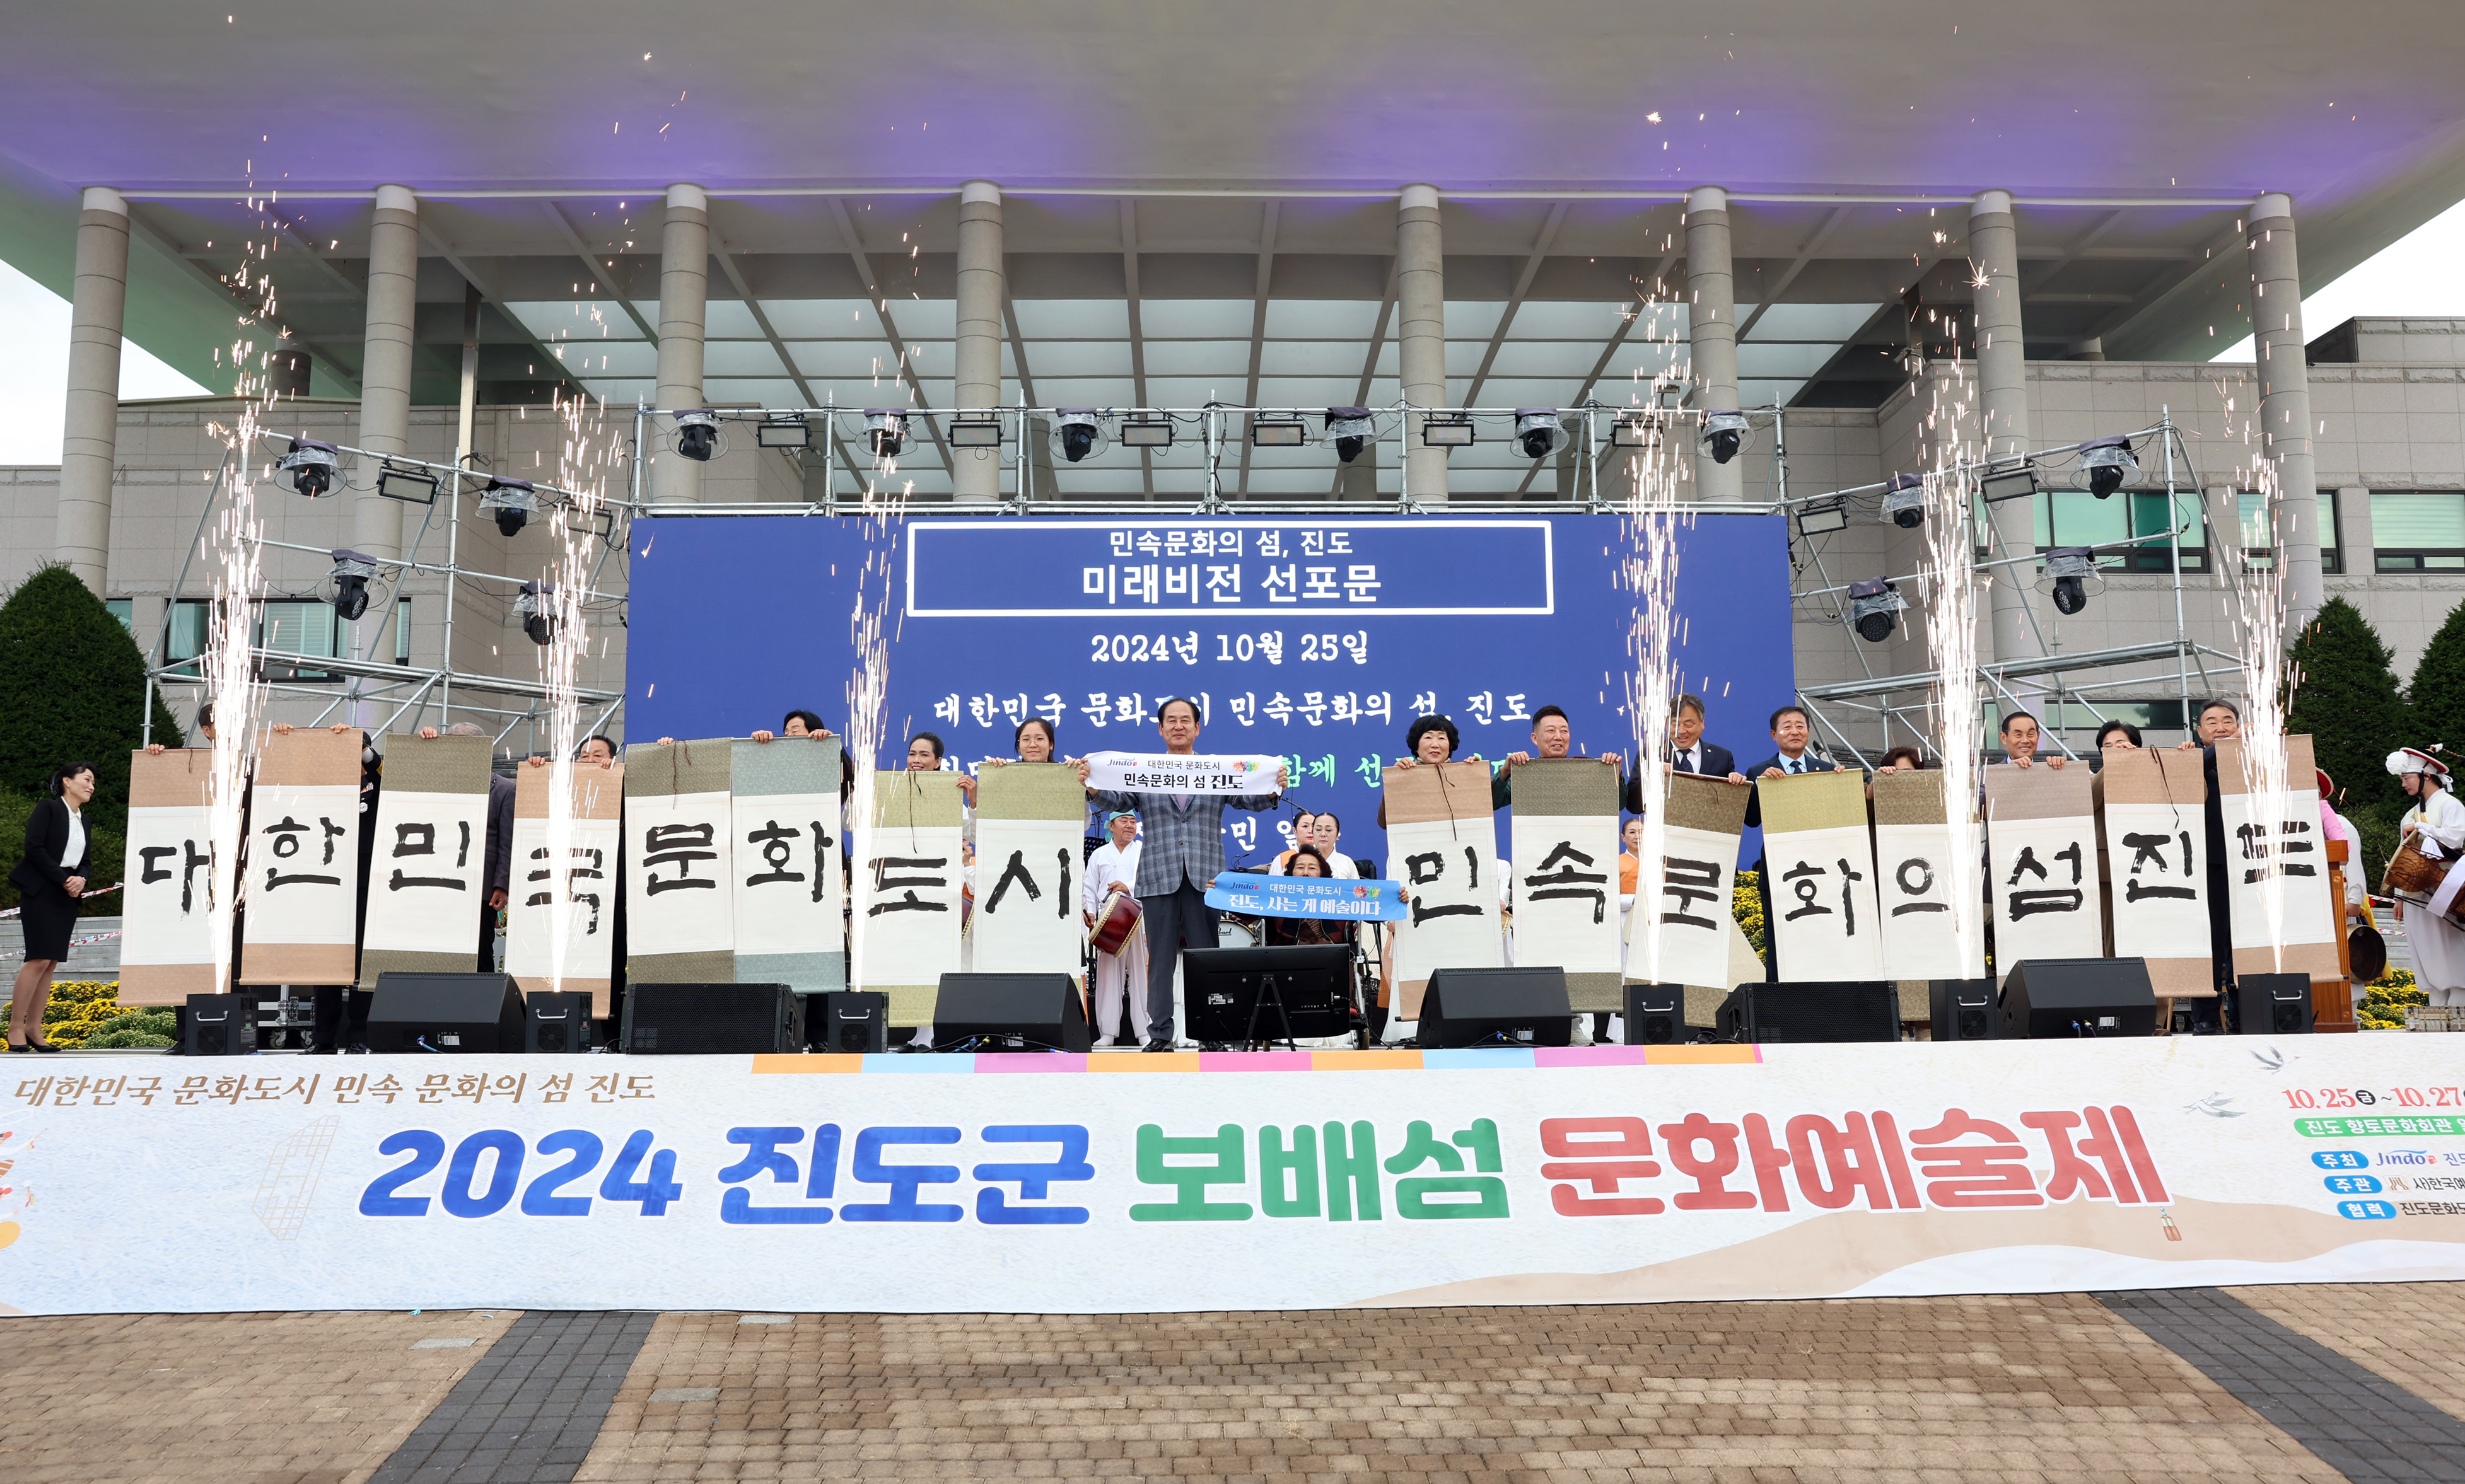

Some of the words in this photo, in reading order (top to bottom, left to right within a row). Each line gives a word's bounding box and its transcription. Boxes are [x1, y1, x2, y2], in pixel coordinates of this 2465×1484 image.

[1110, 530, 1243, 557] 민속문화의
[1256, 530, 1289, 559] 섬,
[1300, 531, 1353, 557] 진도
[1083, 564, 1242, 604] 미래비전
[1261, 564, 1382, 602] 선포문
[1092, 631, 1199, 665] 2024년
[1216, 630, 1283, 665] 10월
[1300, 630, 1368, 664] 25일
[934, 692, 1066, 728] 대한민국
[1229, 691, 1391, 726] 민속문화의
[1466, 690, 1531, 726] 진도
[1148, 759, 1182, 769] 대한민국
[1186, 760, 1220, 770] 문화도시
[1124, 773, 1188, 788] 민속문화의
[1193, 775, 1206, 789] 섬
[1211, 774, 1244, 789] 진도
[1269, 883, 1304, 894] 대한민국
[1307, 884, 1341, 896] 문화도시
[1228, 894, 1263, 911] 진도,
[1267, 896, 1298, 912] 사는
[1302, 898, 1317, 914] 게
[1320, 900, 1382, 916] 예술이다
[14, 1075, 162, 1107] 대한민국
[173, 1074, 320, 1106] 문화도시
[333, 1073, 404, 1104] 민속
[416, 1072, 527, 1104] 문화의
[538, 1072, 573, 1104] 섬
[585, 1072, 656, 1103] 진도
[2304, 1120, 2343, 1135] 진도
[2344, 1118, 2452, 1134] 향토문화회관
[358, 1128, 683, 1218] 2024
[717, 1123, 1096, 1225] 진도군
[1128, 1117, 1511, 1222] 보배섬
[1539, 1104, 2173, 1217] 문화예술제
[2320, 1153, 2359, 1168] 주최
[2376, 1152, 2427, 1166] Jindo
[2334, 1177, 2373, 1192] 주관
[2345, 1203, 2386, 1218] 협력
